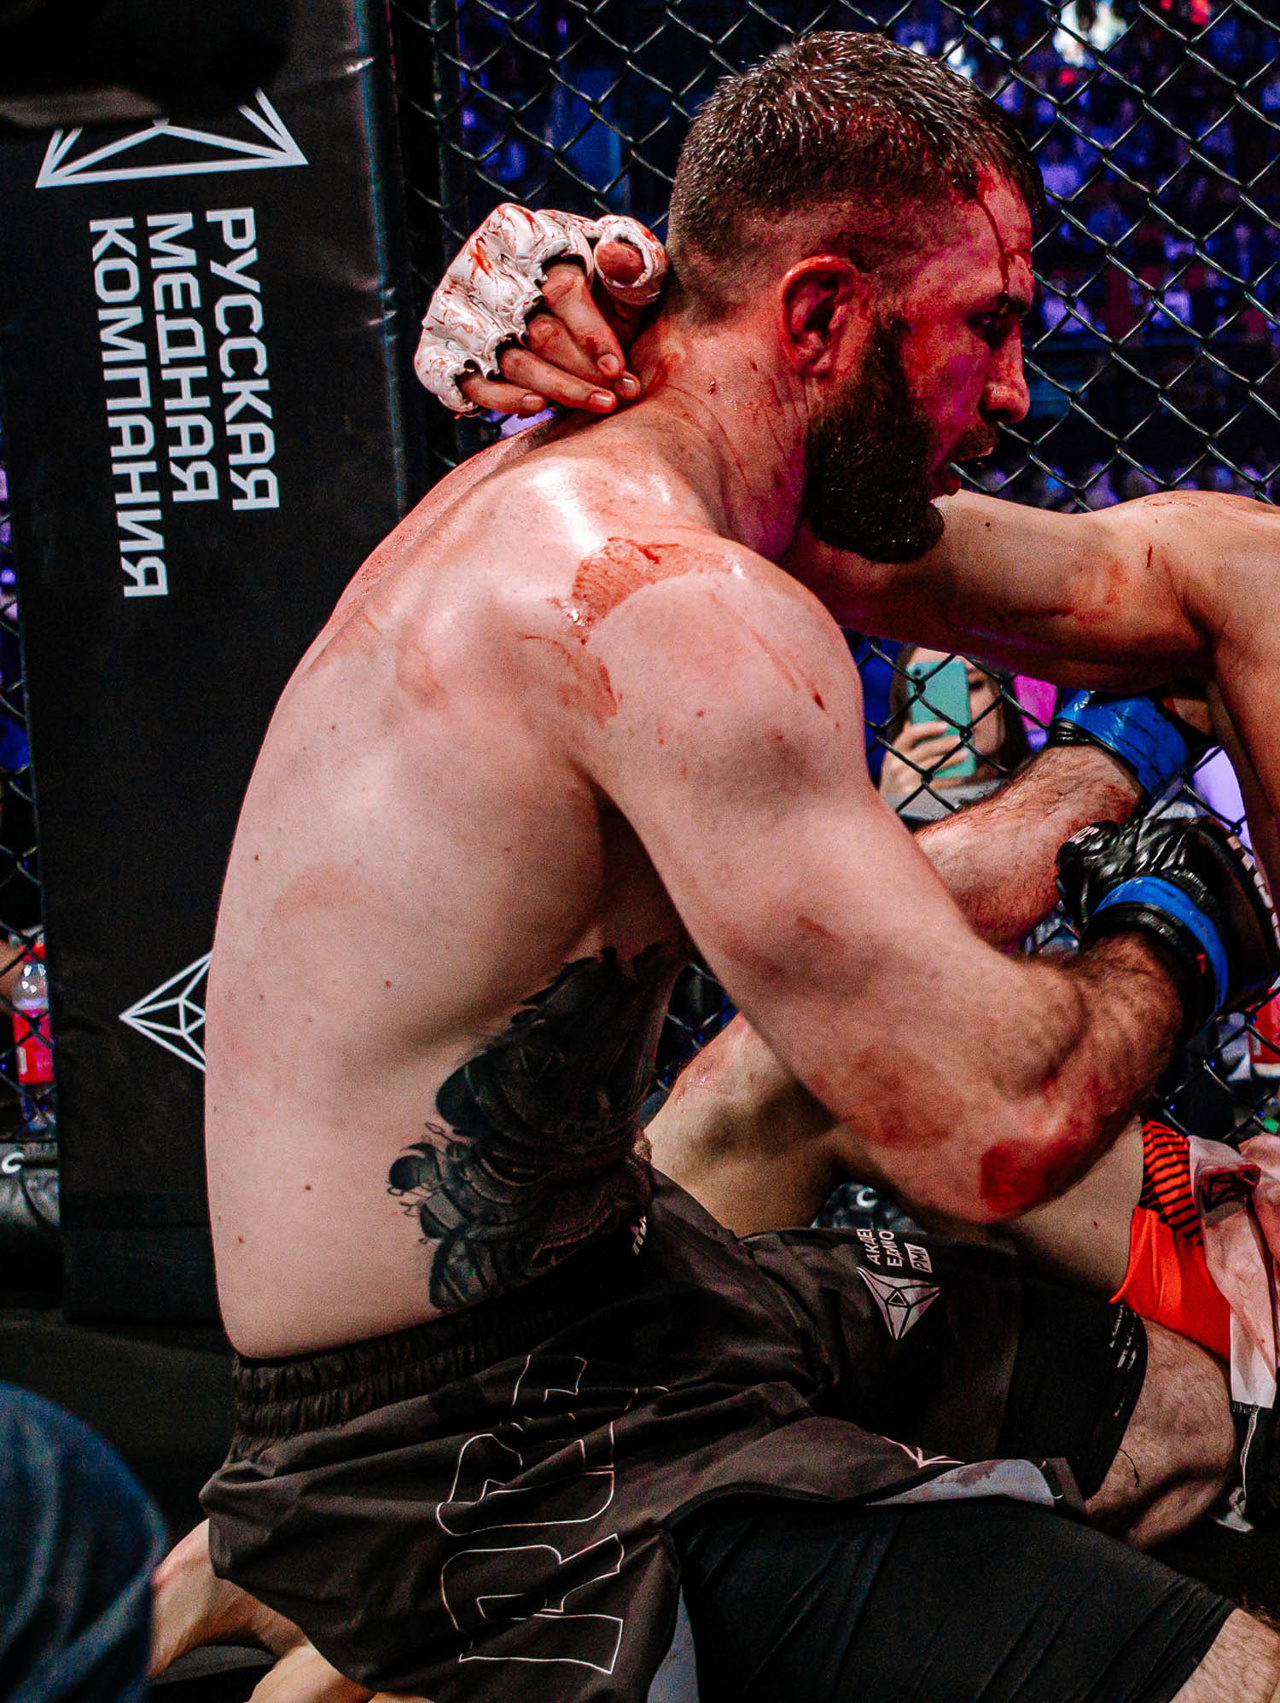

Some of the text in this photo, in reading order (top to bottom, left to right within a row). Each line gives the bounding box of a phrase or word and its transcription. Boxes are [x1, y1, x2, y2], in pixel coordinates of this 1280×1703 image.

[89, 216, 169, 598] КОМПАНИЯ
[146, 211, 219, 503] МЕДНАЯ
[206, 207, 280, 511] РУССКАЯ
